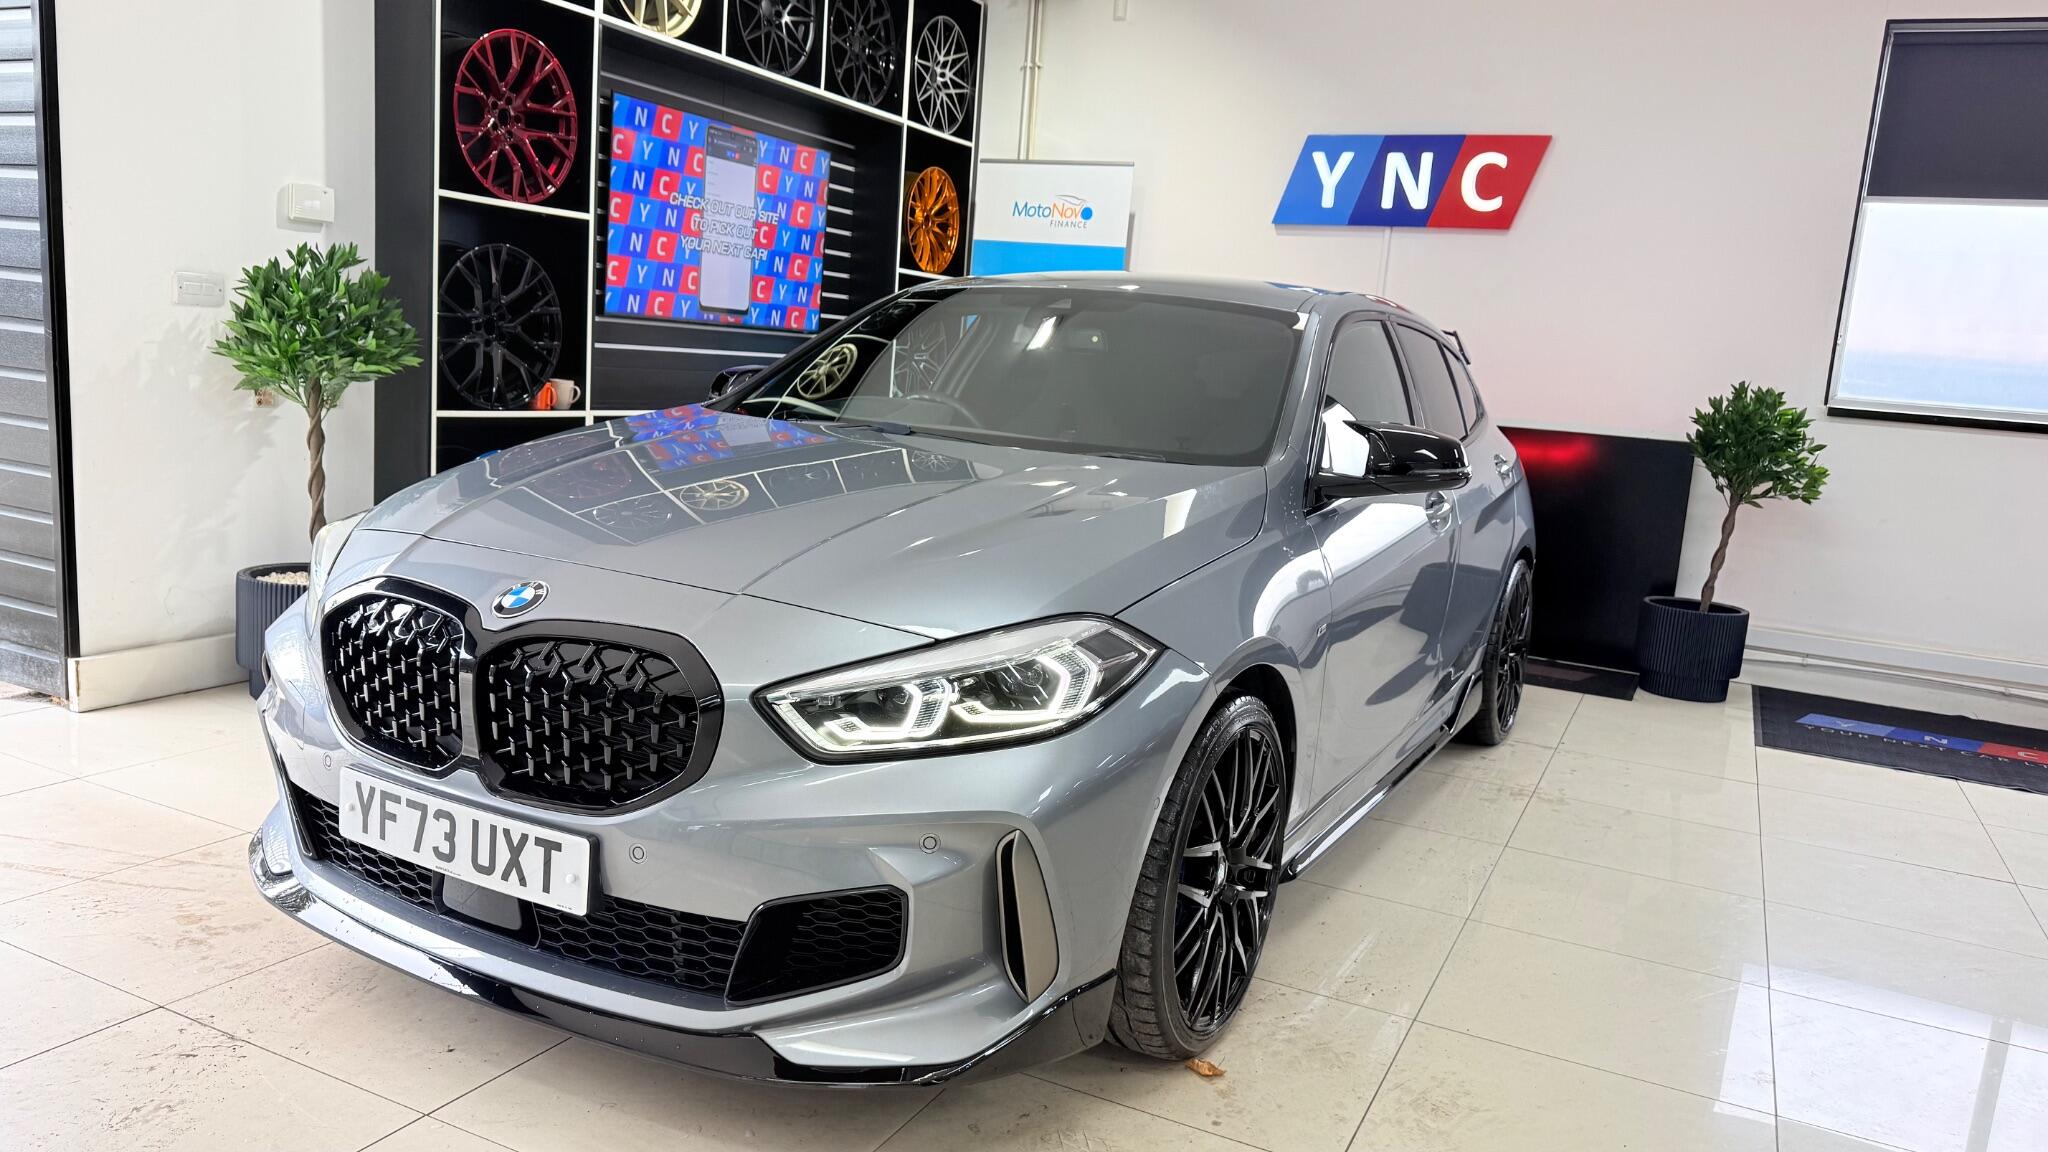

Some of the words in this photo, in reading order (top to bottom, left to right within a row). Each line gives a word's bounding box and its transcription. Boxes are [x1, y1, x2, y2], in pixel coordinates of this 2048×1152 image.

[1312, 151, 1508, 212] YNC
[669, 191, 709, 212] CHECK
[710, 199, 735, 217] OUT
[735, 204, 757, 221] OUR
[758, 210, 780, 225] SITE
[694, 216, 709, 231] TO
[709, 218, 736, 237] PICK
[736, 225, 758, 241] OUT
[1049, 219, 1088, 229] FINANCE
[680, 235, 712, 252] YOUR
[712, 239, 744, 258] NEXT
[355, 780, 457, 864] YF73
[470, 818, 563, 895] UXT
